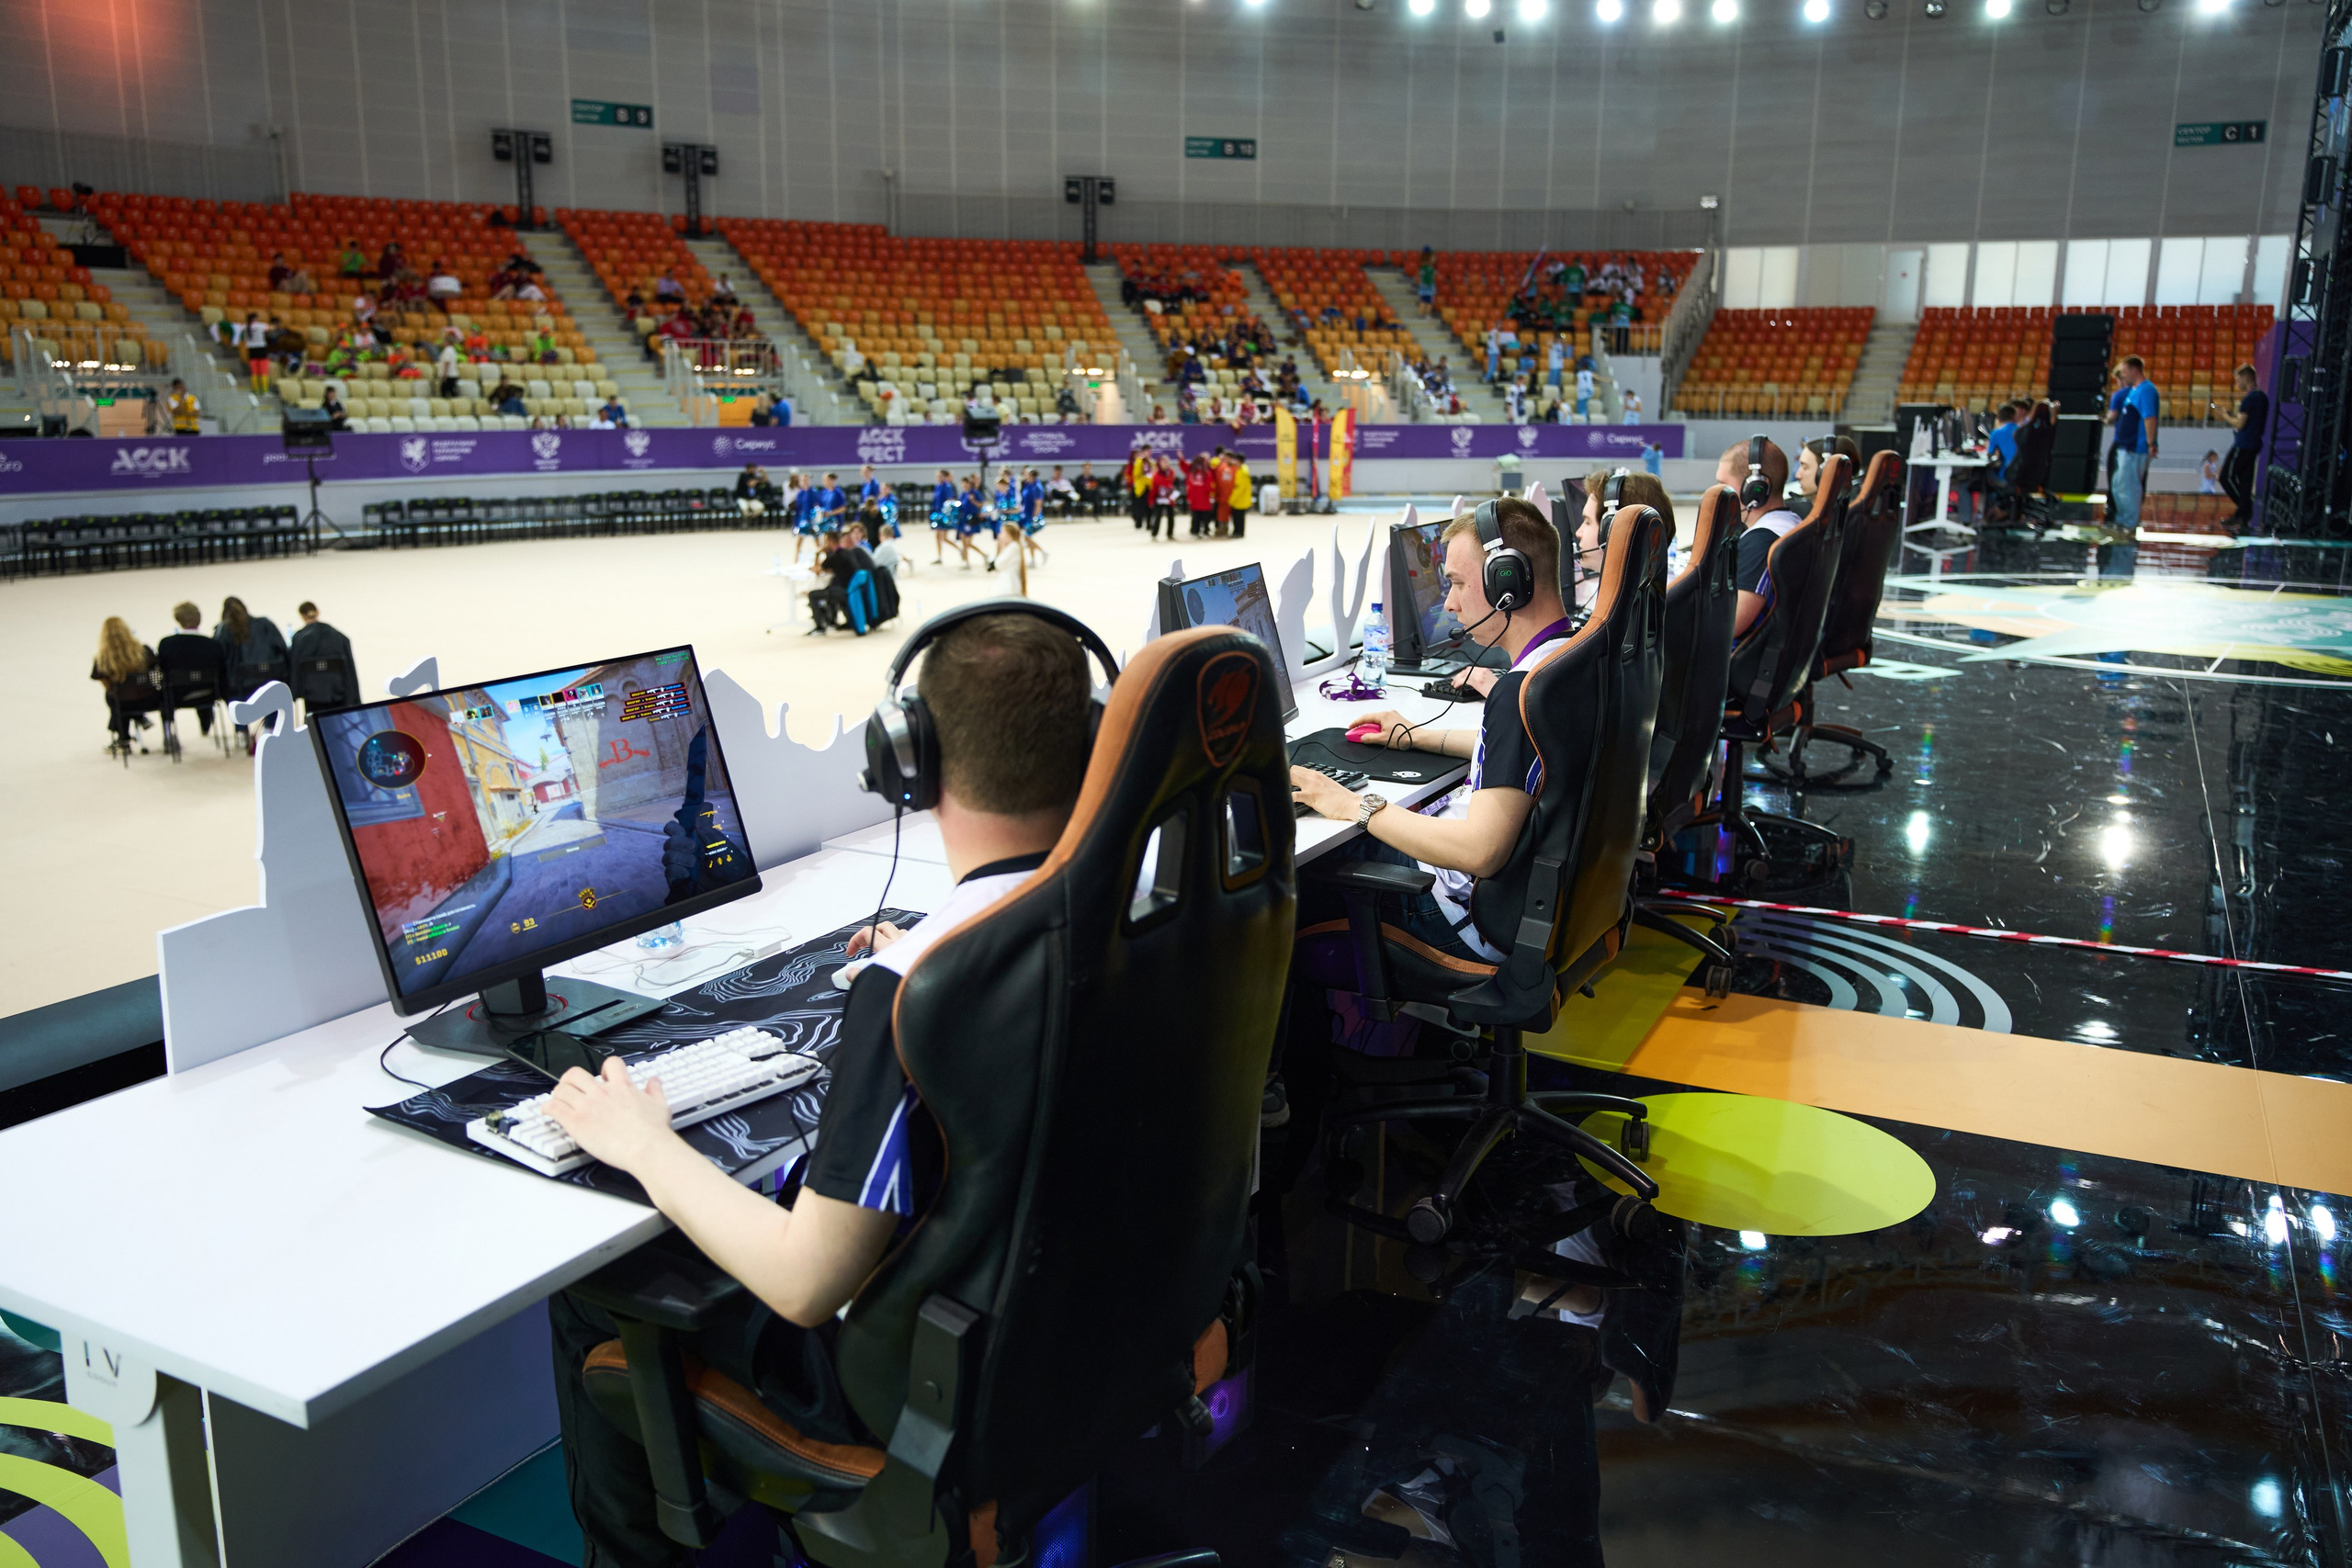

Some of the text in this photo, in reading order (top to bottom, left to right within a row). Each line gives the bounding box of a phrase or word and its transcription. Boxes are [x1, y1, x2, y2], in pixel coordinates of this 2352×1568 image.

[2249, 124, 2257, 140] 1
[734, 437, 777, 452] Сириус
[109, 446, 190, 472] АССК
[856, 446, 906, 463] ФЕСТ
[609, 739, 634, 764] B
[414, 948, 448, 965] $11100
